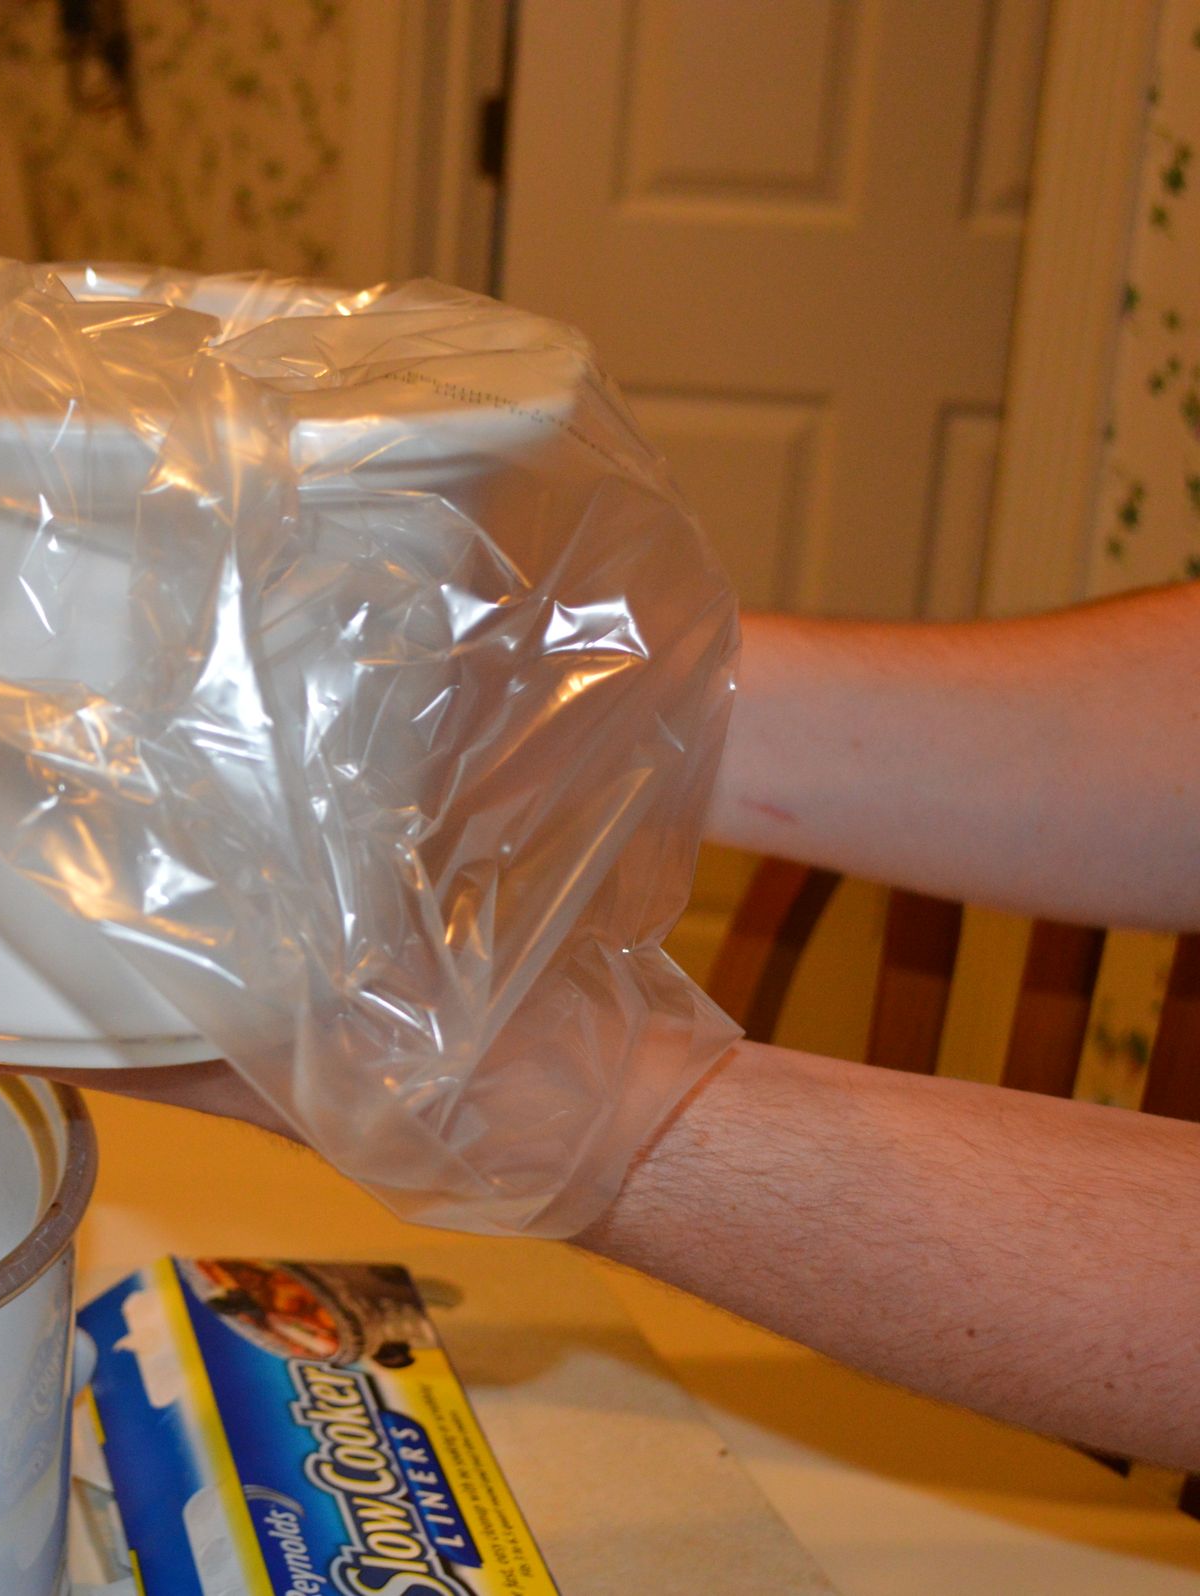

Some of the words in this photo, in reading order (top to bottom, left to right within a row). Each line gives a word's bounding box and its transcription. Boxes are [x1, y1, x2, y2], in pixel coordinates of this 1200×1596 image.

[303, 1365, 397, 1495] Cooker
[389, 1426, 466, 1548] LINERS
[346, 1497, 453, 1596] Slow
